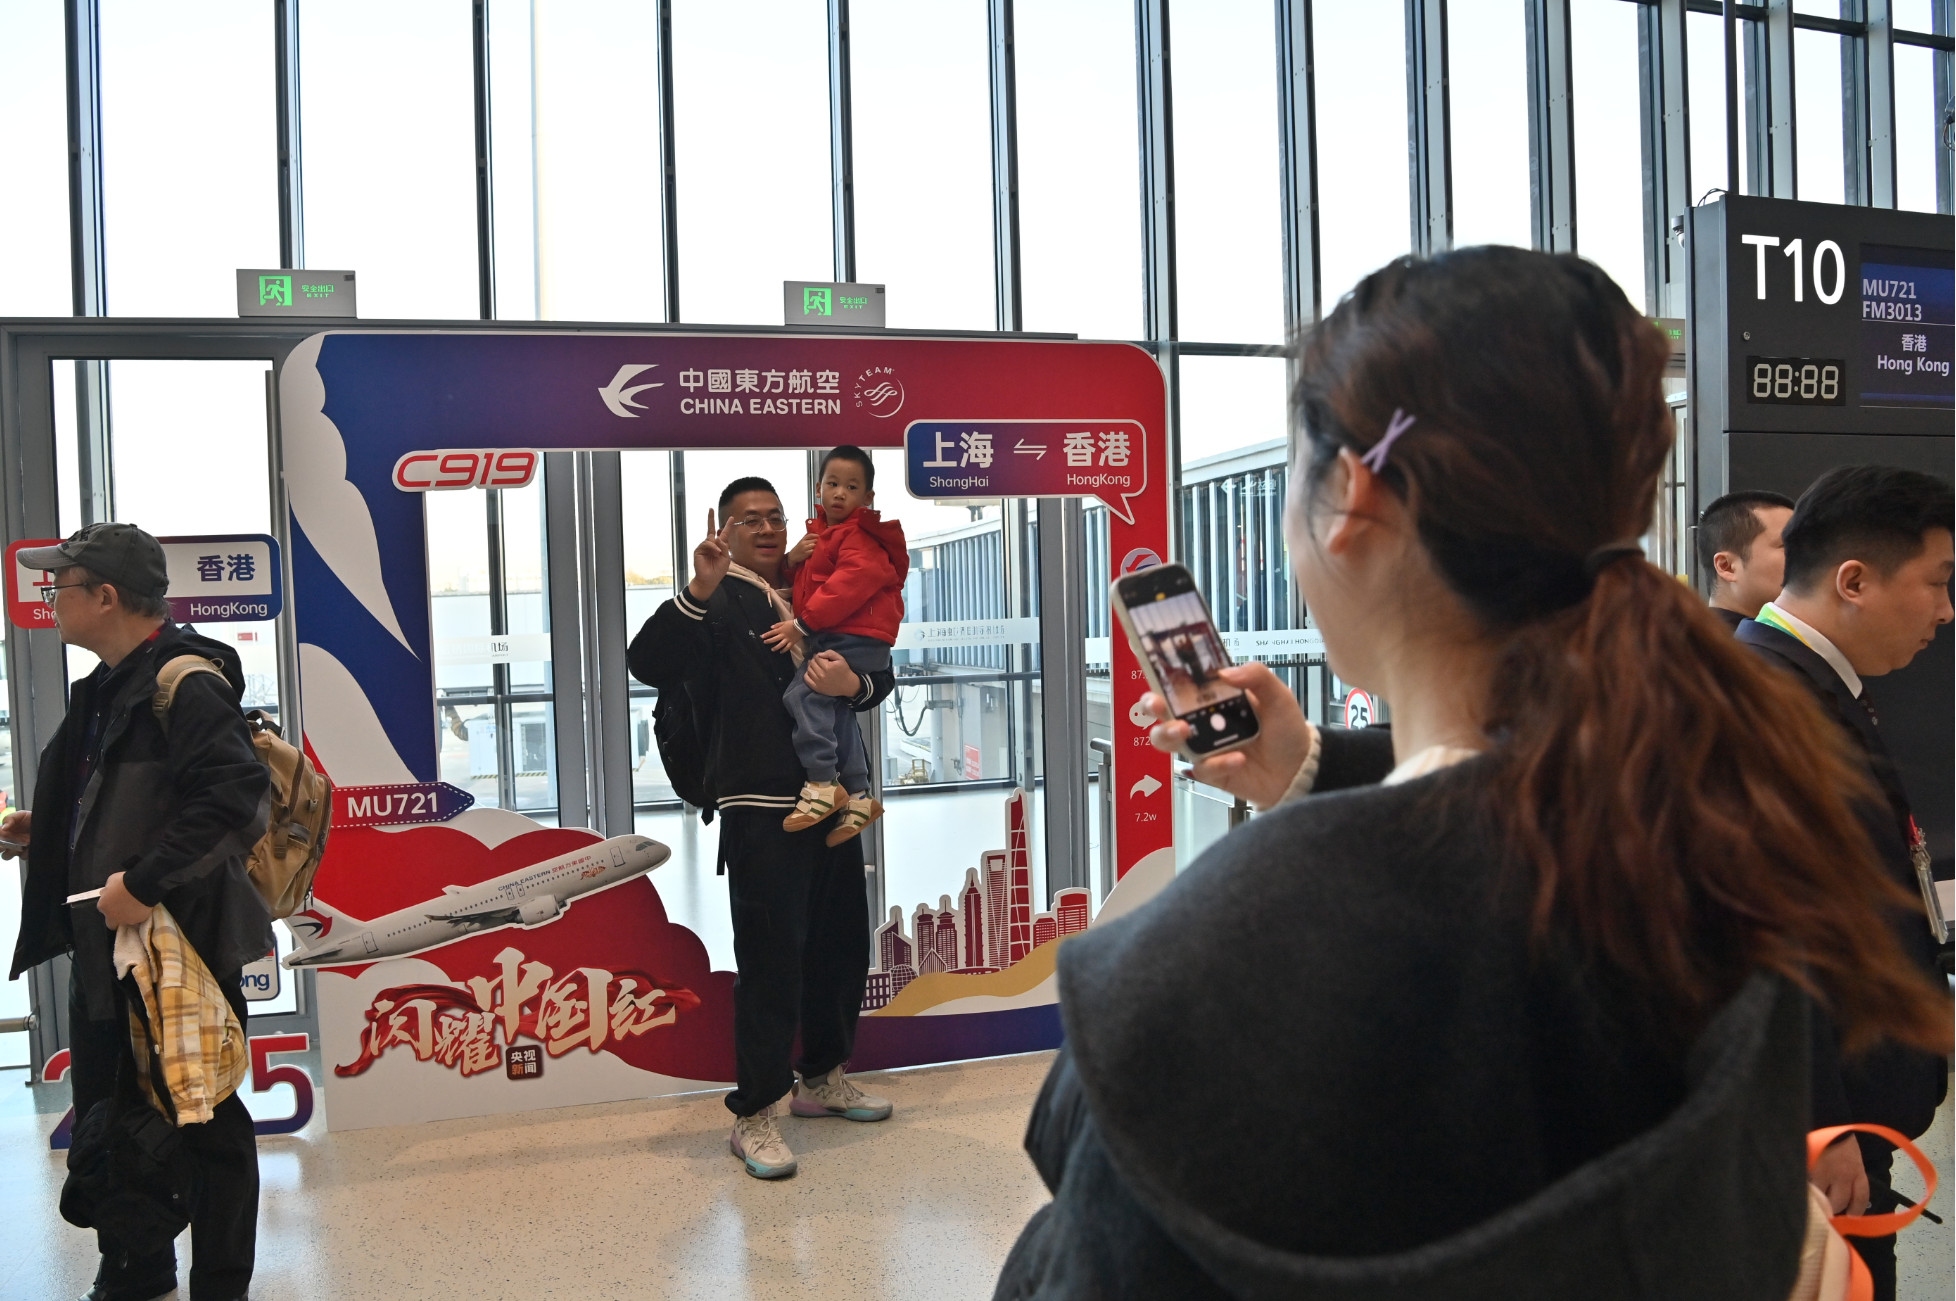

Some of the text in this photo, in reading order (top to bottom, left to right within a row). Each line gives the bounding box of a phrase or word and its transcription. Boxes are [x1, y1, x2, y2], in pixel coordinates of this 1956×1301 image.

[1742, 234, 1846, 305] T10
[301, 284, 334, 293] 安全出口
[1862, 278, 1917, 299] MU721
[1862, 300, 1922, 321] FM3013
[1901, 333, 1927, 352] 香港
[1877, 355, 1950, 377] Hong Kong
[679, 367, 841, 394] 中國東方航空
[854, 366, 894, 408] SKYTEAM
[1753, 363, 1839, 399] 88:88
[680, 398, 841, 415] CHINA EASTERN
[922, 431, 1131, 469] 上海 香港
[397, 452, 535, 488] C919
[929, 473, 1131, 490] ShangHai HongKong
[197, 553, 256, 583] 香港
[190, 602, 268, 619] HongKong
[1350, 704, 1369, 728] 25
[347, 791, 438, 818] MU721
[1134, 812, 1157, 822] 7.2w
[519, 869, 551, 884] EASTERN
[240, 973, 270, 992] ong
[510, 1049, 537, 1063] 央视
[511, 1062, 537, 1075] 新闻
